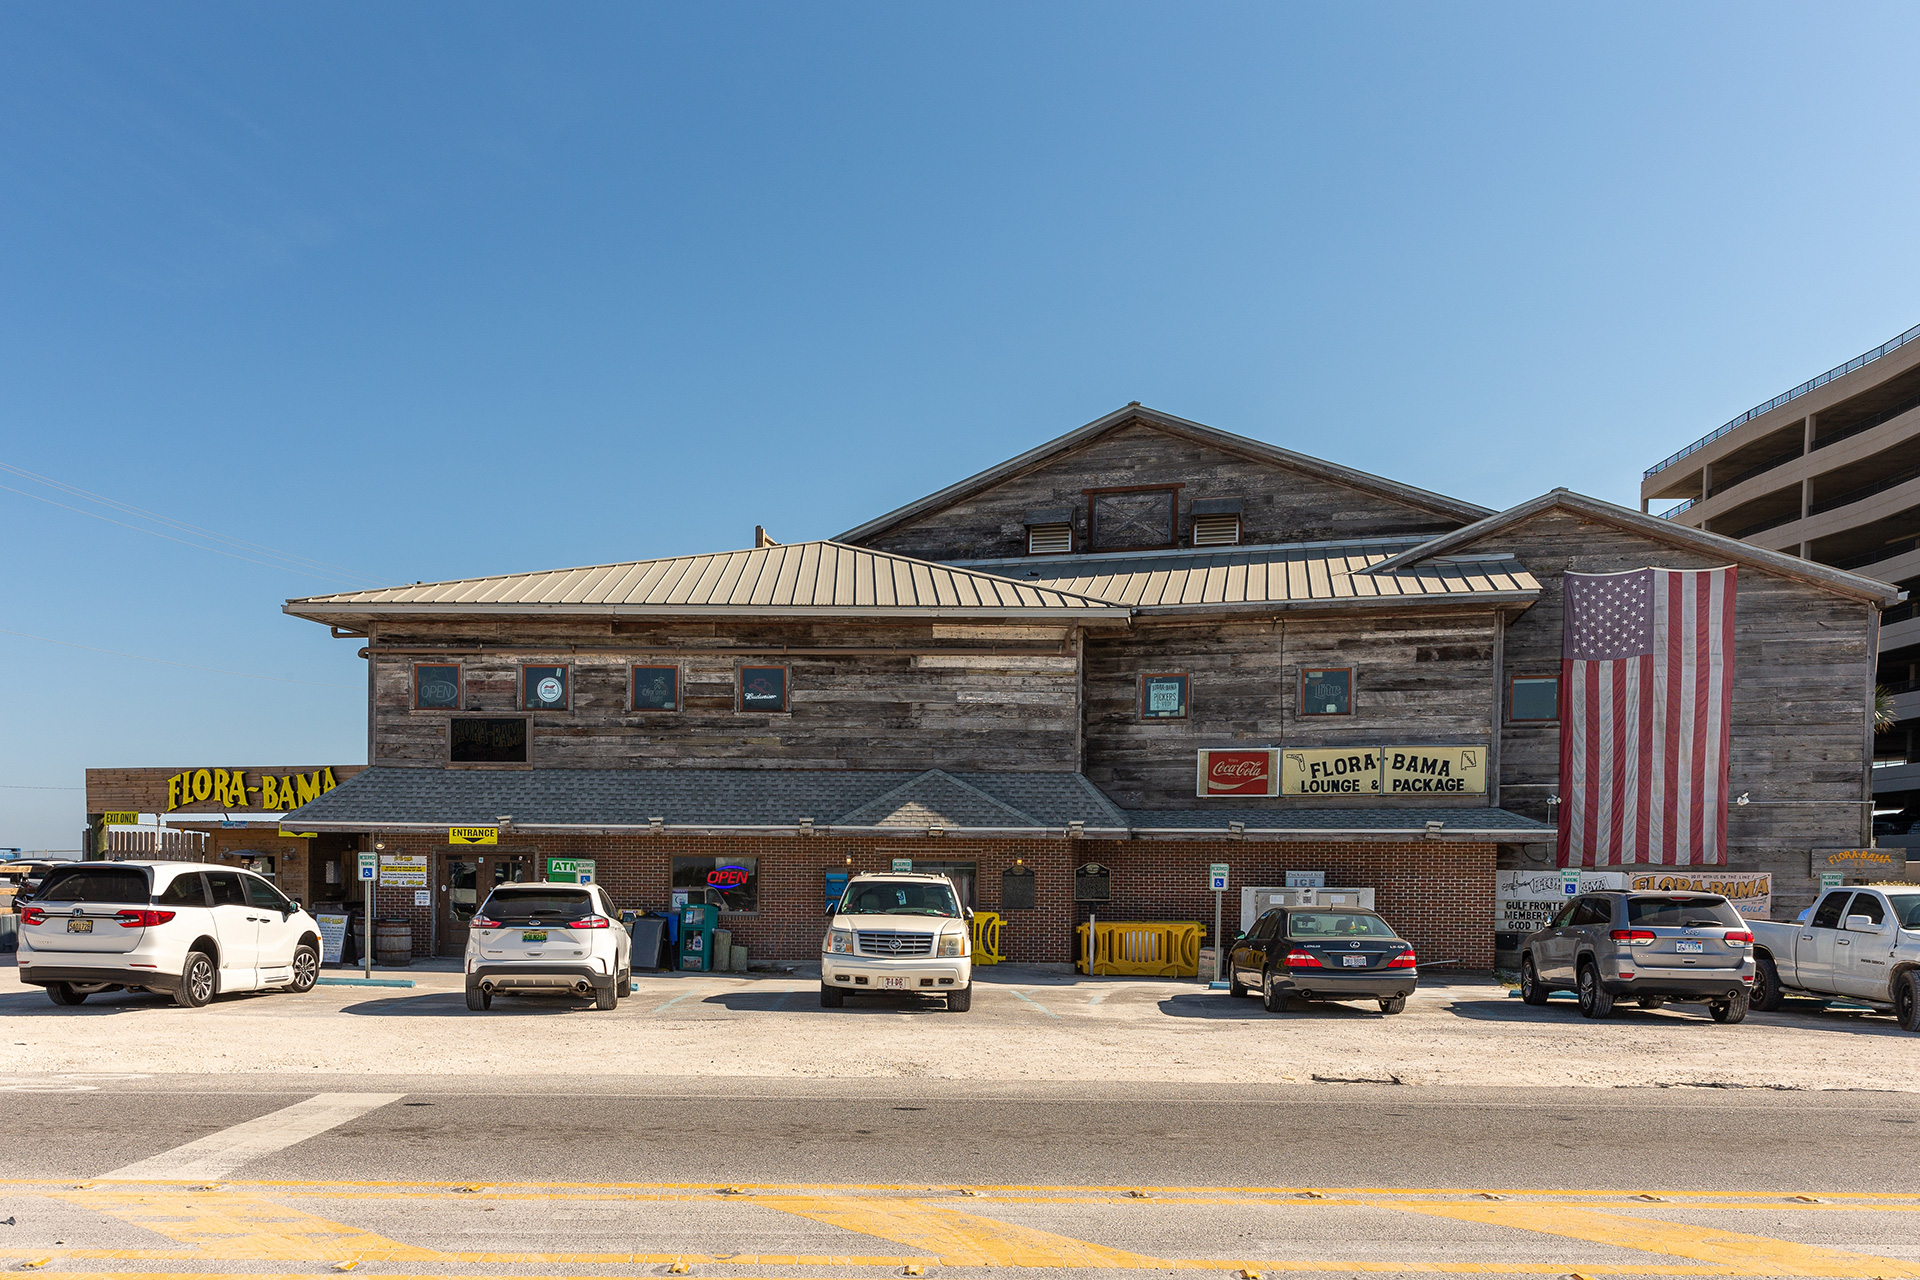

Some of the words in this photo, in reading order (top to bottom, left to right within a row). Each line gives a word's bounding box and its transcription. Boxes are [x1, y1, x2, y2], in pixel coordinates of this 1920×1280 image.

[421, 685, 450, 698] OPEN
[1212, 760, 1264, 776] Coca-Cola
[166, 767, 337, 812] FLORA-BAMA
[1301, 779, 1360, 793] LOUNGE
[1370, 780, 1379, 790] &
[1392, 778, 1464, 792] PACKAGE
[106, 813, 119, 823] EXIT
[120, 813, 136, 824] ONLY
[452, 828, 494, 837] ENTRANCE
[707, 871, 748, 884] OPEN
[1294, 878, 1316, 886] ICE
[1506, 901, 1527, 910] GULF
[1530, 902, 1557, 910] FRONT
[1508, 921, 1531, 930] GOOD
